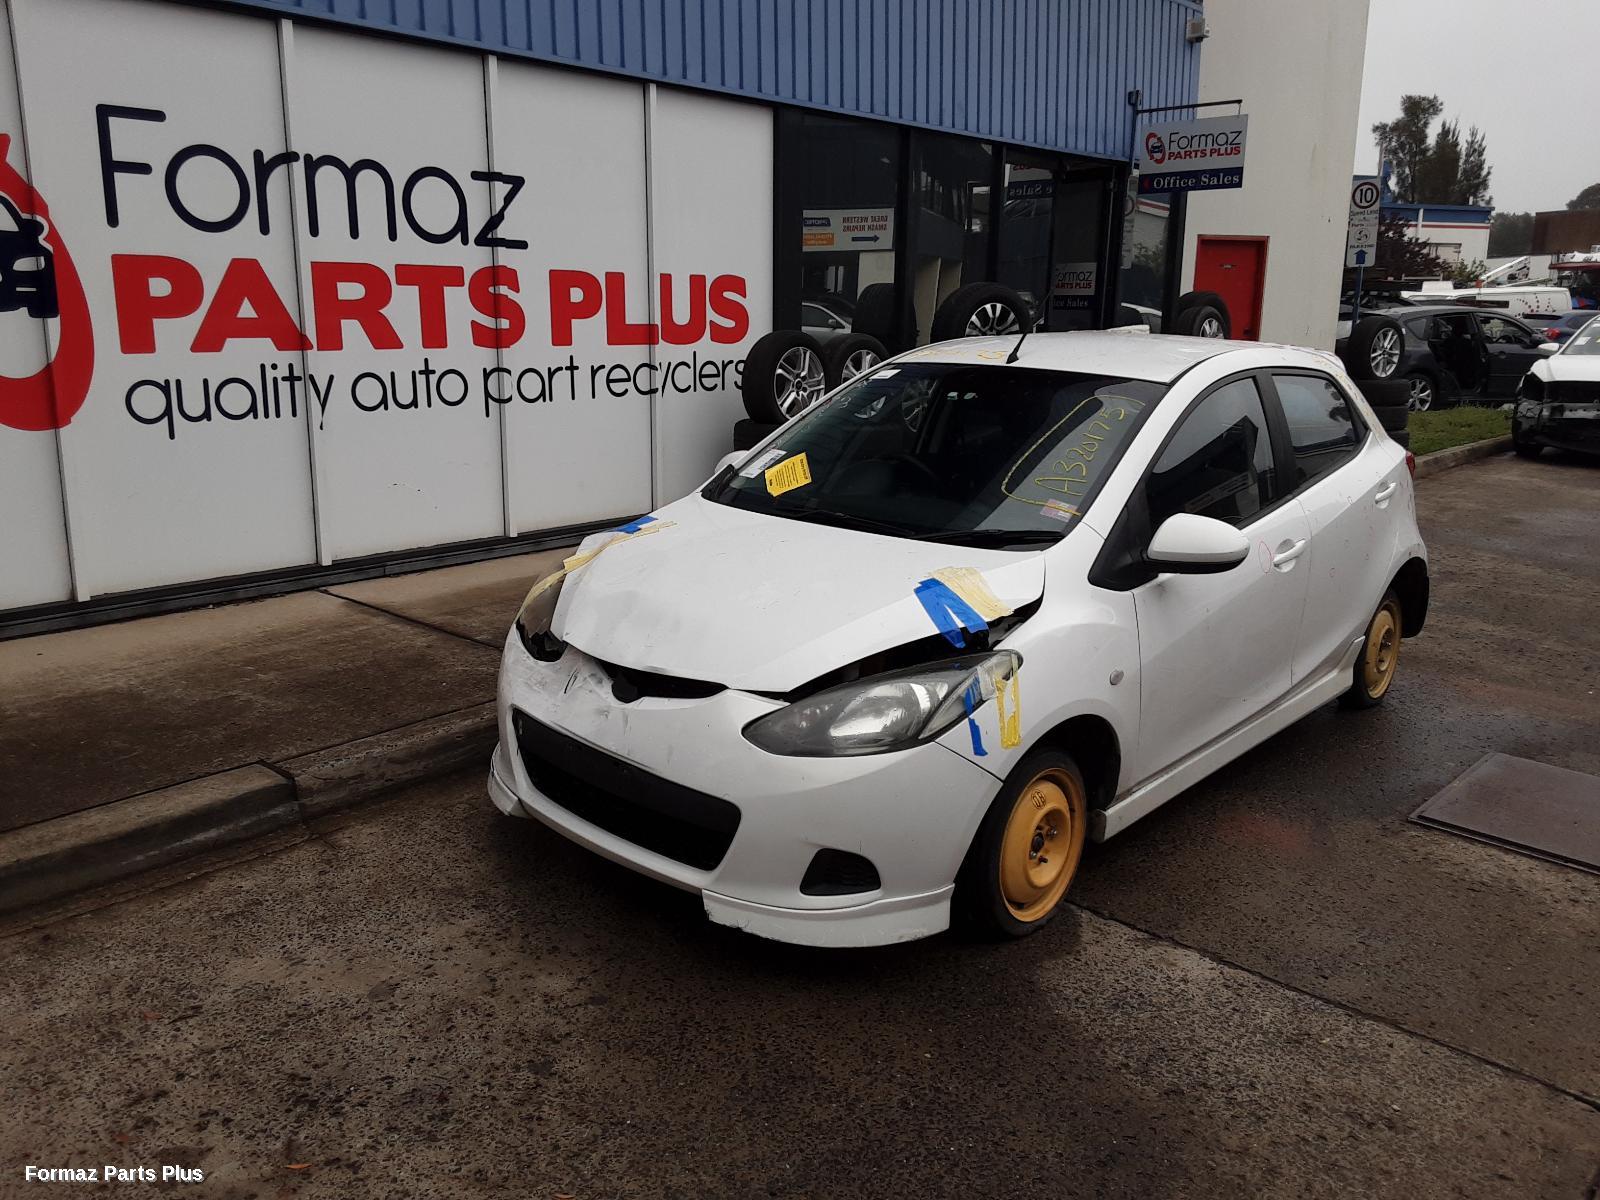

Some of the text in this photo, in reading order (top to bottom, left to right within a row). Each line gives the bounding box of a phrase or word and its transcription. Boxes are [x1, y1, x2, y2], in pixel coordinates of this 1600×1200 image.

[1168, 131, 1243, 151] Formaz
[1167, 146, 1241, 160] PARTS PLUS
[95, 104, 529, 250] Formaz
[1153, 172, 1240, 189] Office Sales
[1359, 187, 1374, 204] 10
[111, 254, 750, 355] PARTS PLUS
[125, 350, 746, 440] quality auto part recyclers
